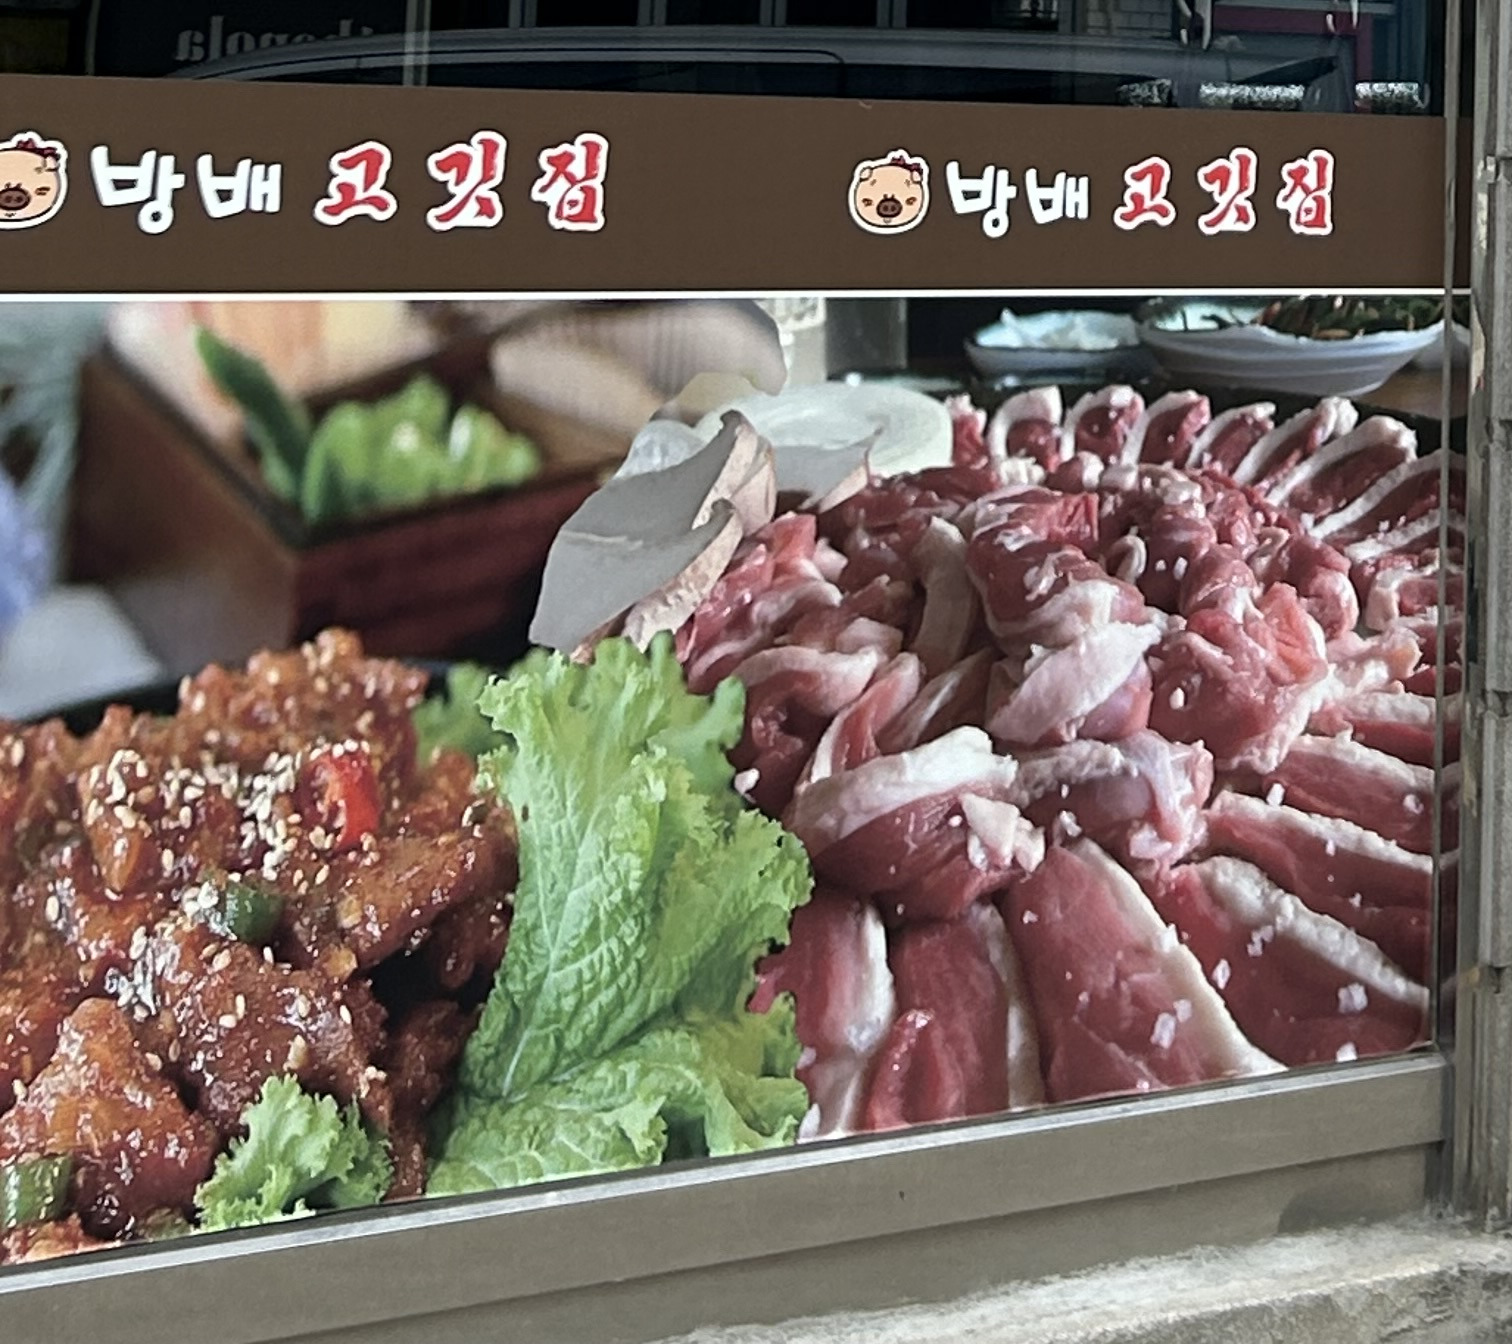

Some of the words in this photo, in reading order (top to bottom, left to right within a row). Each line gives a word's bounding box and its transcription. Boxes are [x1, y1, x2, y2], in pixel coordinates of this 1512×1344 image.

[91, 144, 283, 235] 방배
[311, 130, 609, 232] 고깃집
[945, 160, 1089, 238] 방배
[1112, 146, 1336, 236] 고깃집
